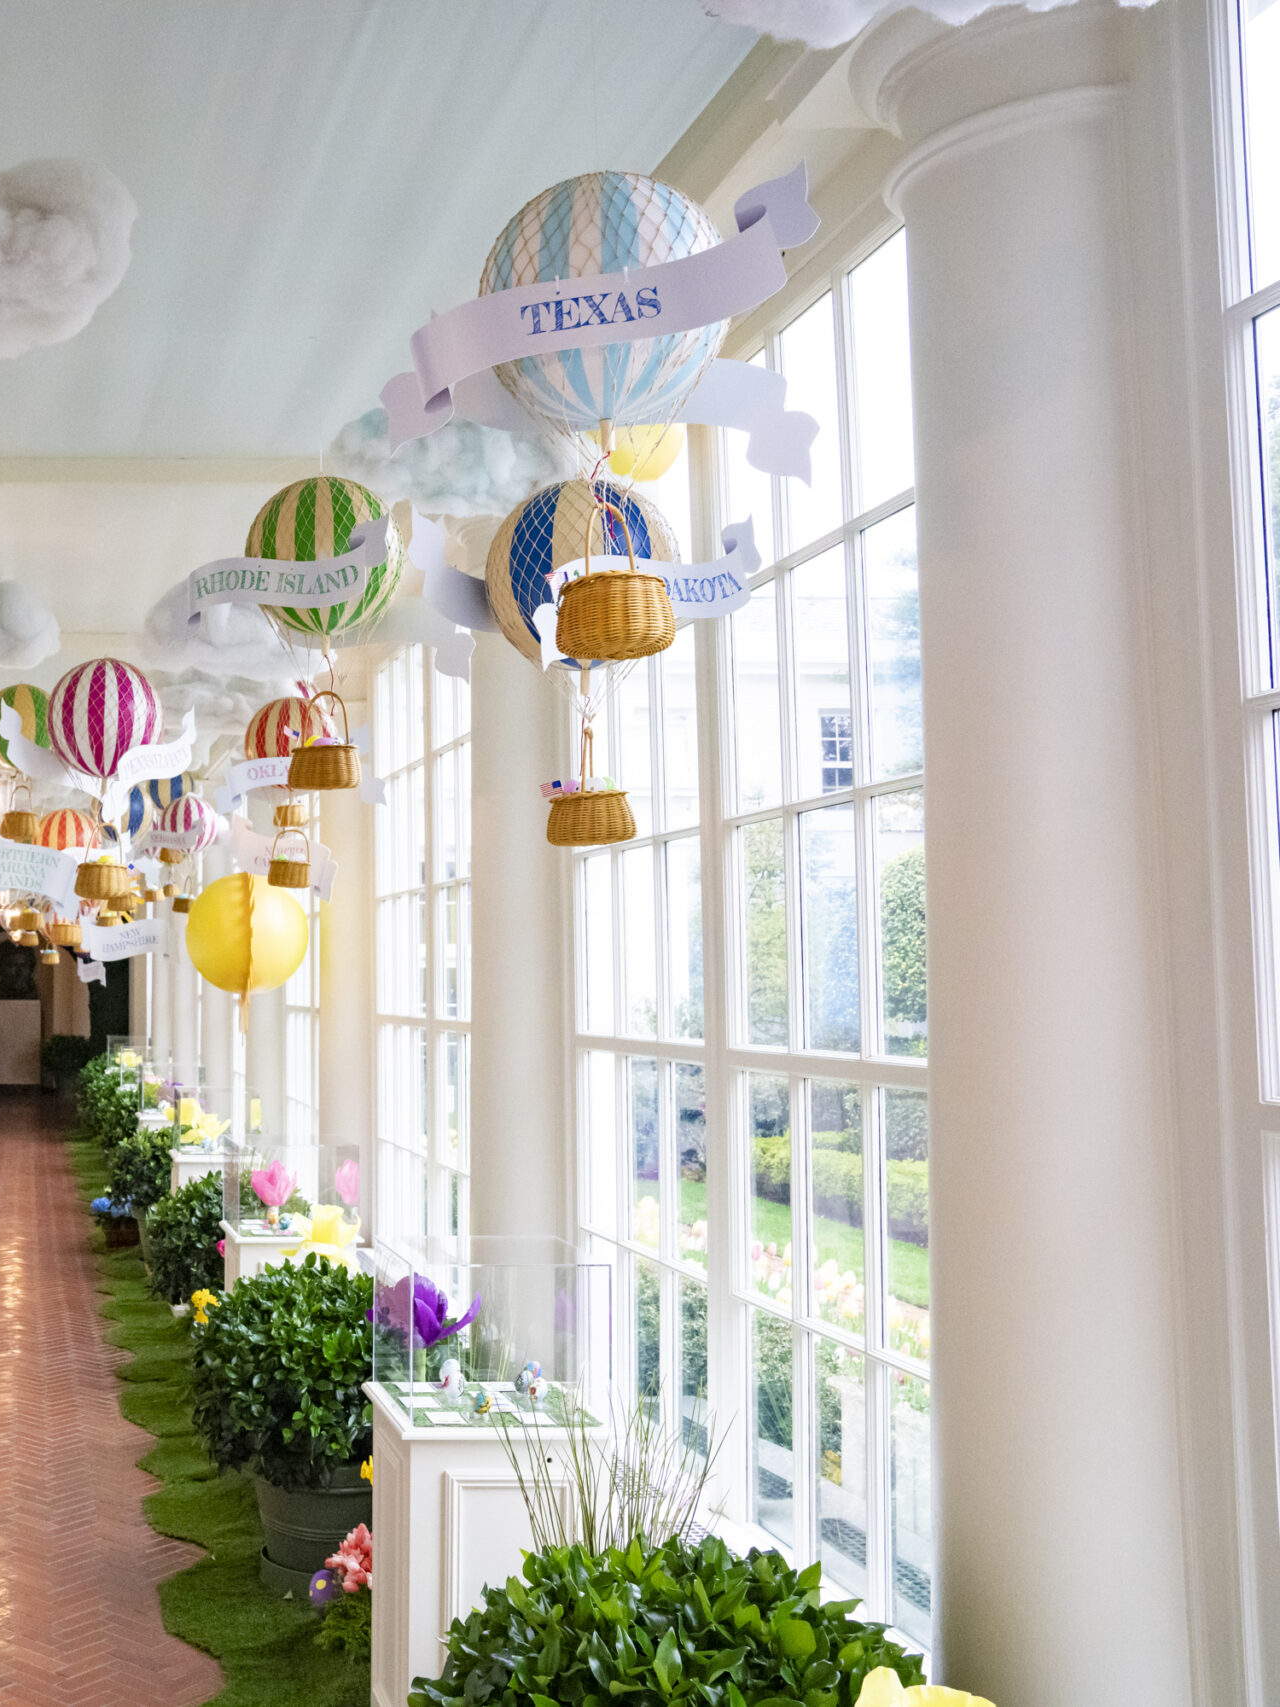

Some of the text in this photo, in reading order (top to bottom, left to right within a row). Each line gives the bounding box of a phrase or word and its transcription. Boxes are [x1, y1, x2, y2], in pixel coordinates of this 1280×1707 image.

[520, 286, 662, 336] TEXAS
[194, 564, 359, 600] RHODE ISLAND
[101, 935, 160, 953] HAMPSHIRE
[120, 928, 141, 940] NEW
